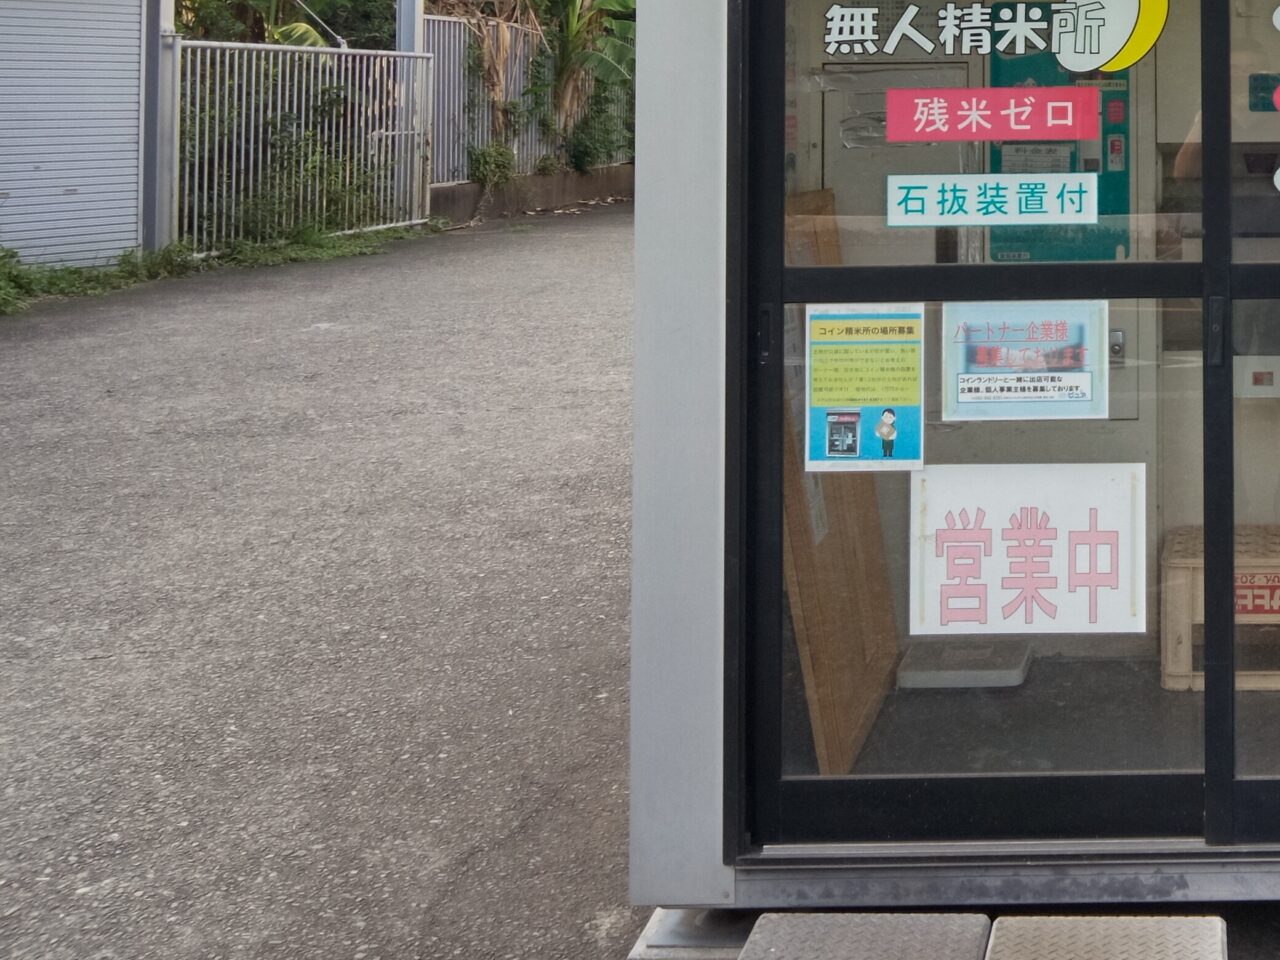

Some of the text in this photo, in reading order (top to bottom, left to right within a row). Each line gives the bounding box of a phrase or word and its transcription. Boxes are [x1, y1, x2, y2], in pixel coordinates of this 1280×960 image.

[824, 2, 1105, 56] 無人精米所
[913, 96, 1074, 133] 残米ゼロ
[897, 182, 1089, 216] 石抜装置付
[935, 507, 1119, 626] 営業中
